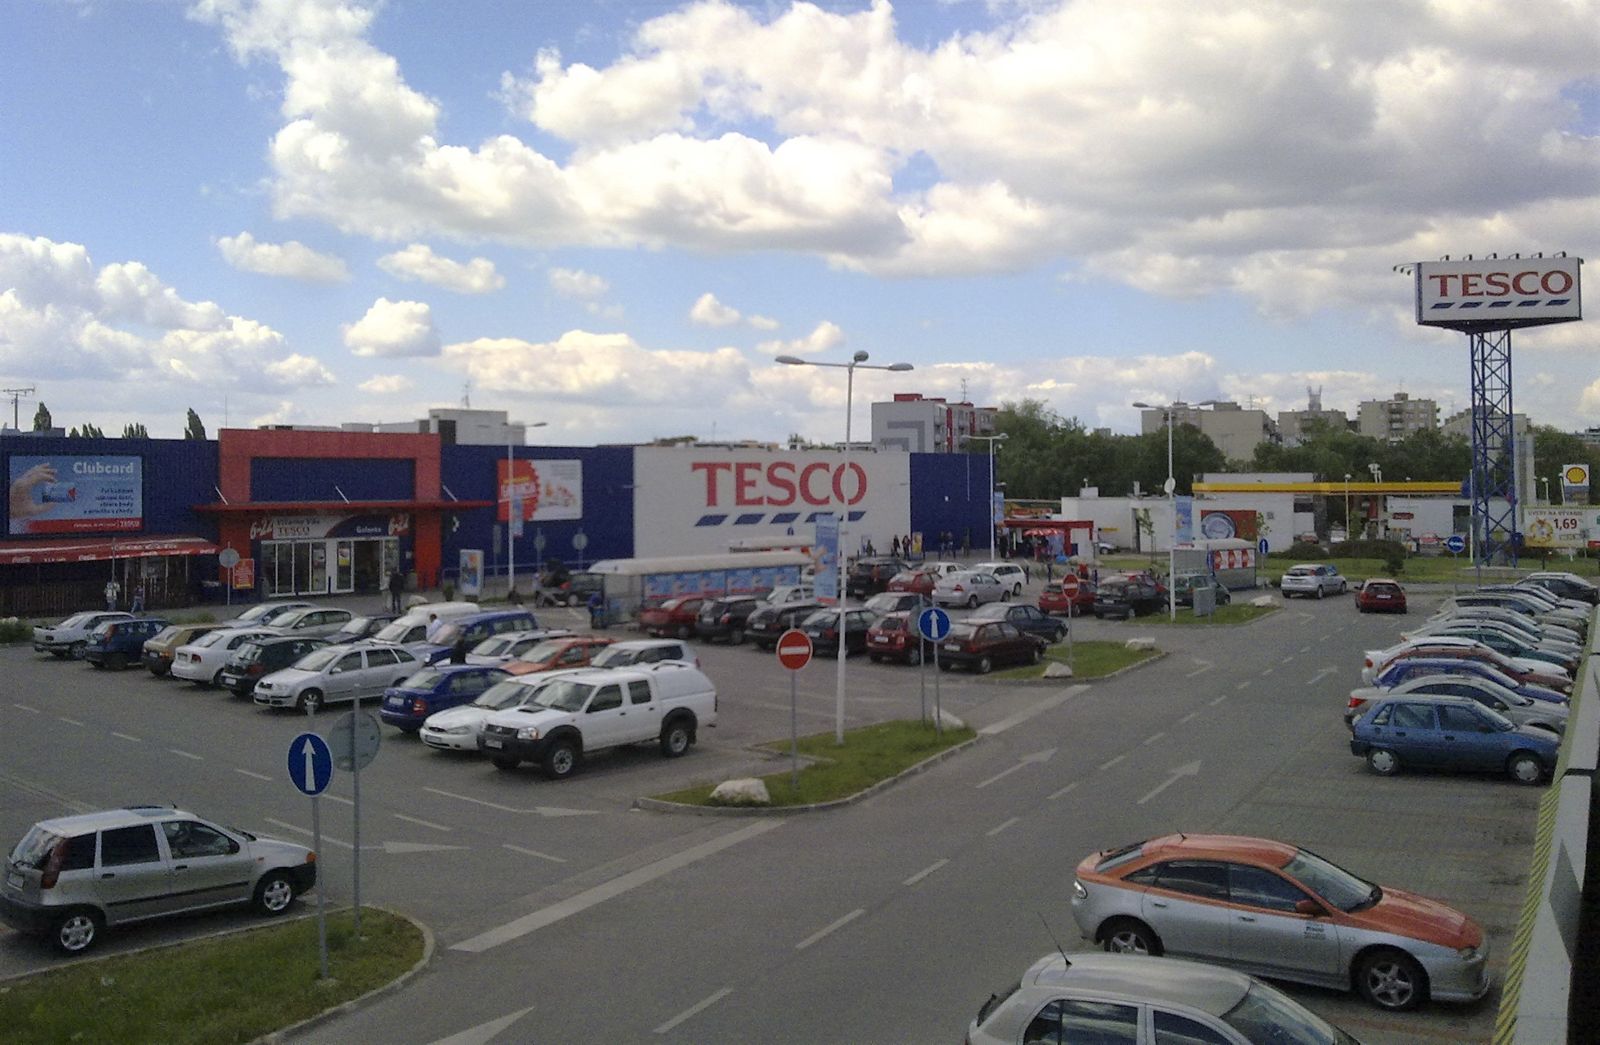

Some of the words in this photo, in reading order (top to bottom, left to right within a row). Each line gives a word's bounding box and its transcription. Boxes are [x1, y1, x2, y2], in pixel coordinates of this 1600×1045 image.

[1429, 270, 1573, 297] TESCO
[73, 462, 133, 474] Clubcard
[691, 461, 867, 507] TESCO
[1554, 518, 1577, 531] 1,69
